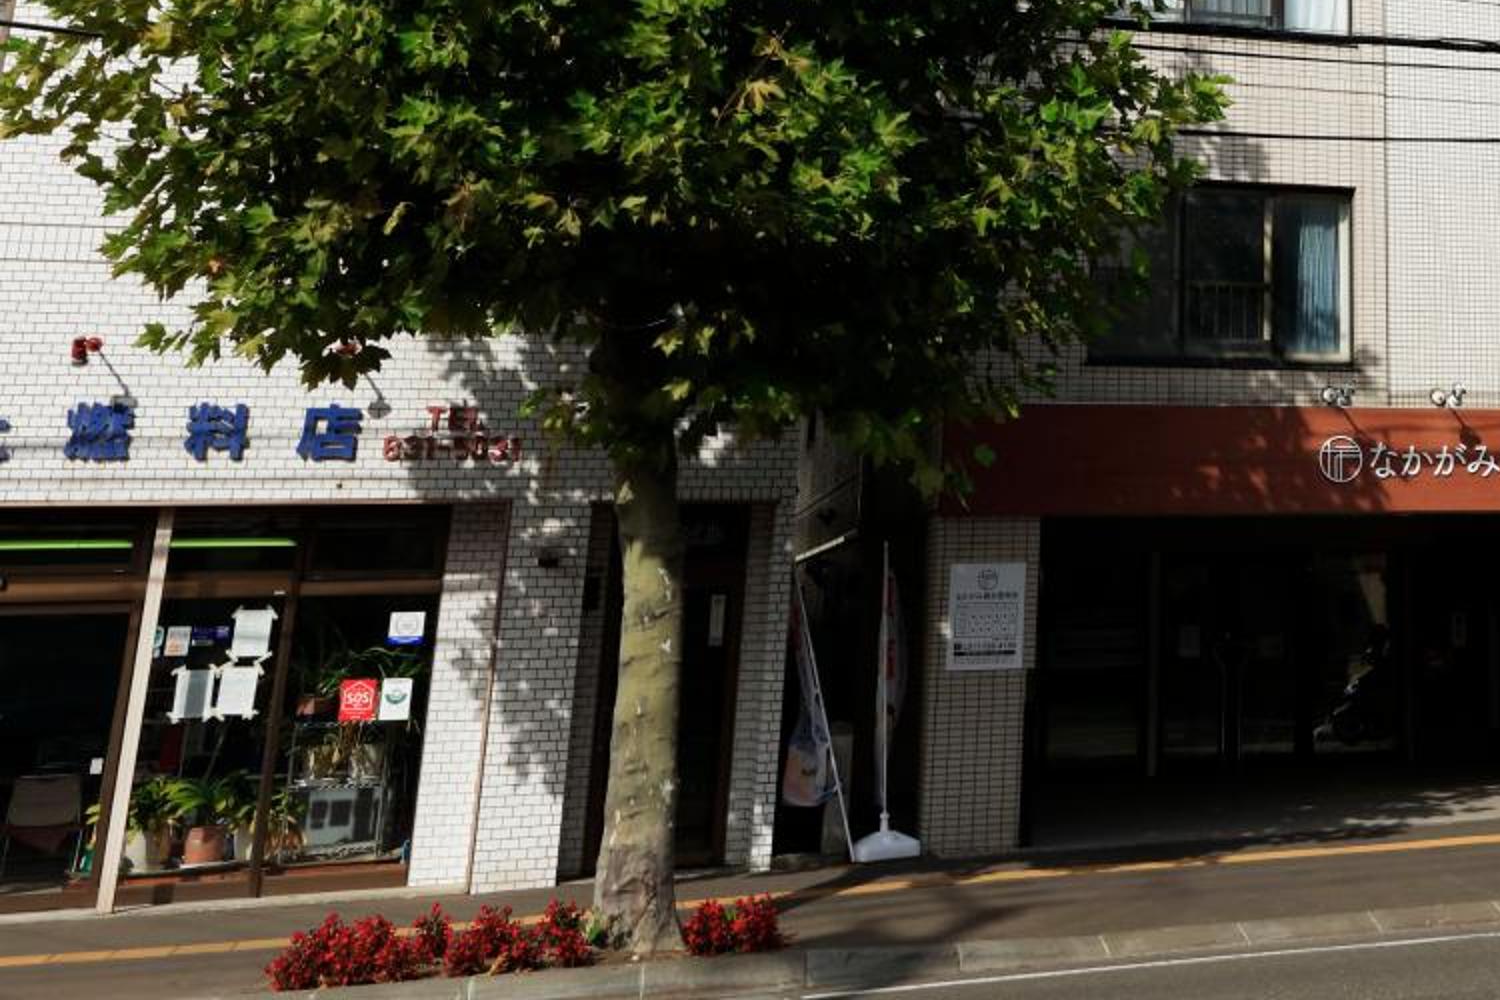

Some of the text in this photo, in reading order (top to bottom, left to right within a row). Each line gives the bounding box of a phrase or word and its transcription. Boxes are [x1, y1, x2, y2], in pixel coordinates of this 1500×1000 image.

[0, 402, 363, 462] 燃料店
[426, 405, 484, 430] TEL
